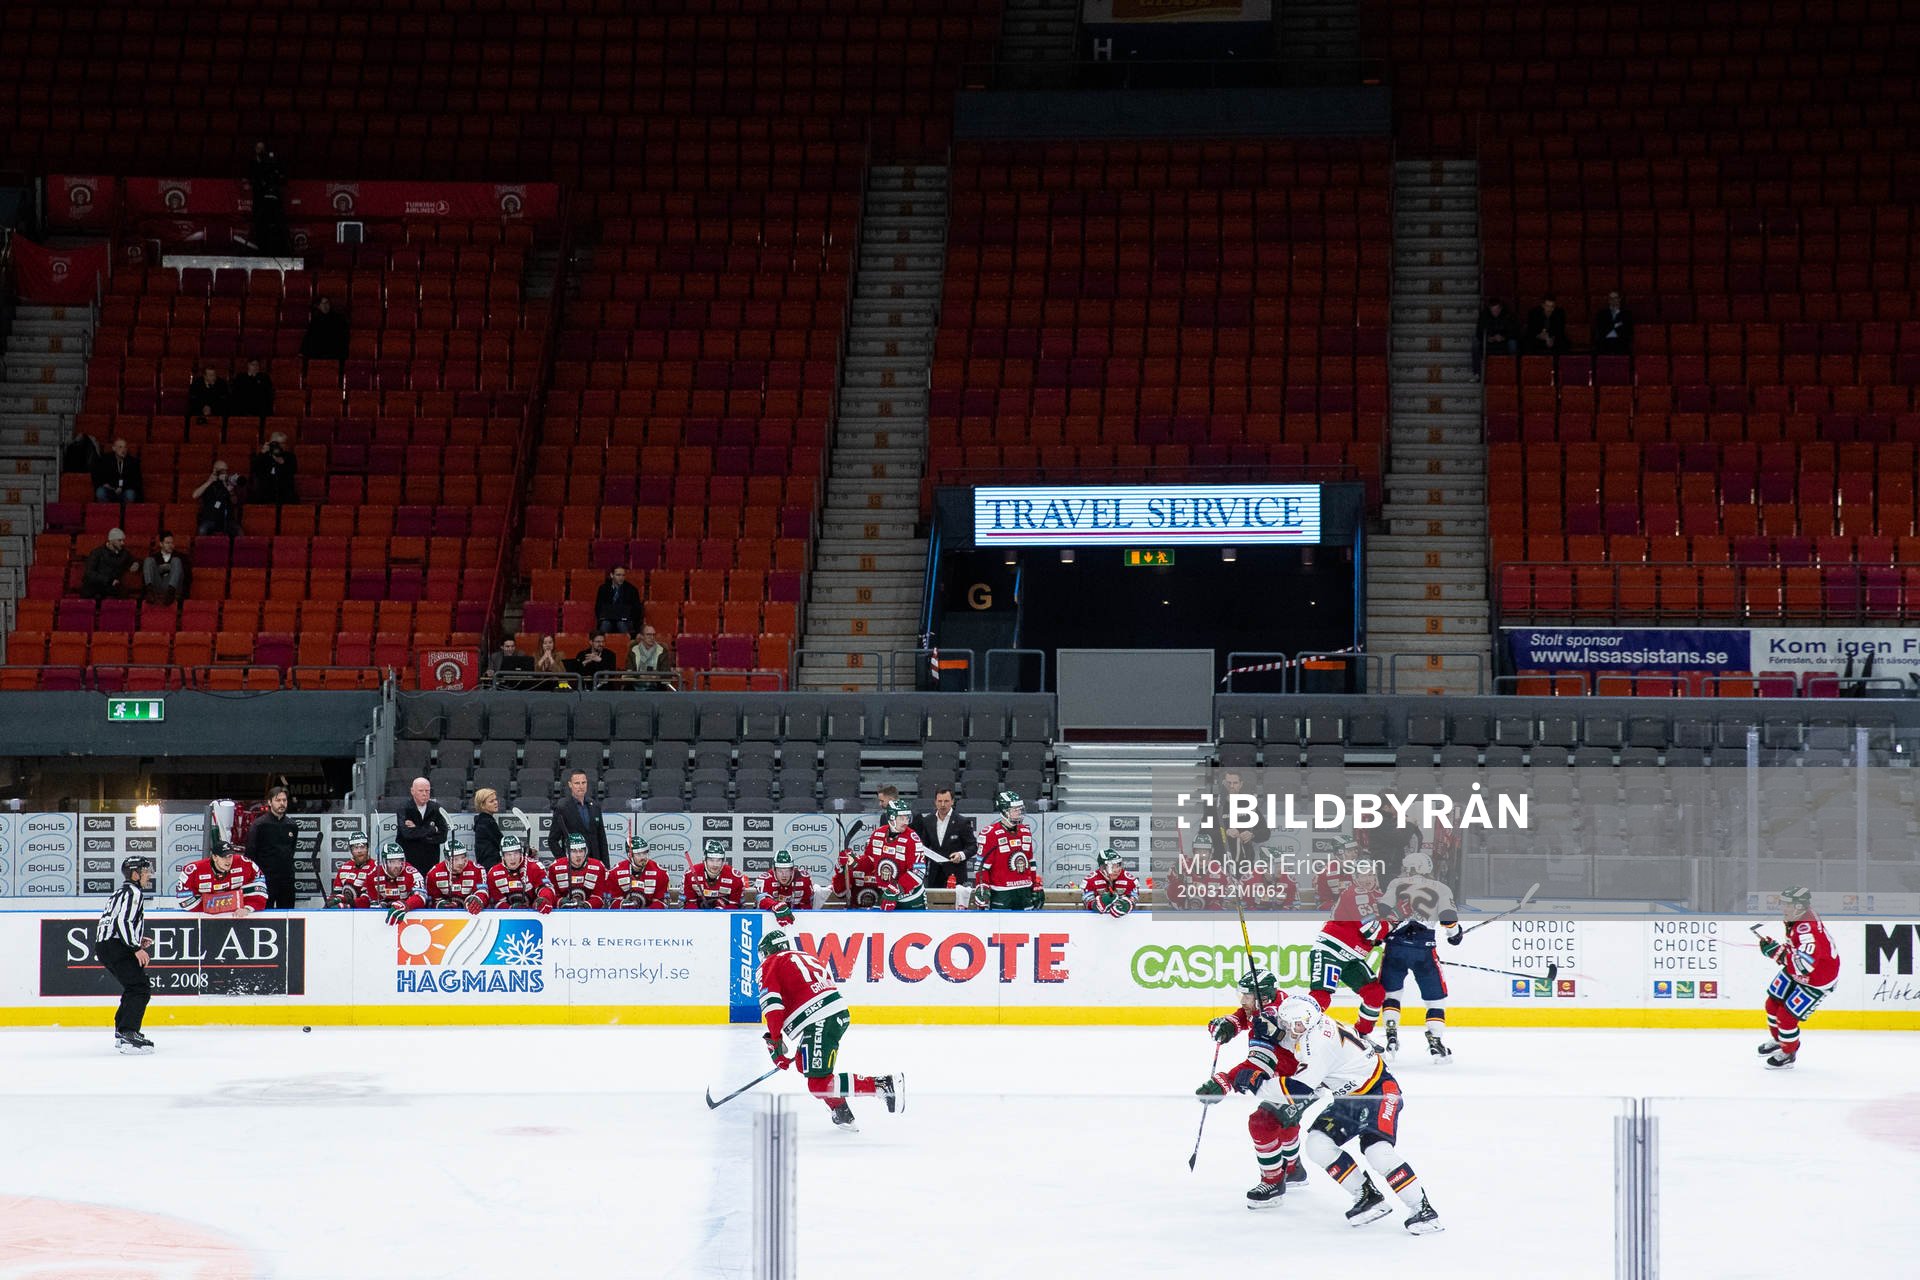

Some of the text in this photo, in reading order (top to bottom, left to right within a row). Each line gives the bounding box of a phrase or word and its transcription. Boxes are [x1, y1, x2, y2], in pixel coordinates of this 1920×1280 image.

[1094, 38, 1112, 60] H
[986, 496, 1303, 530] TRAVEL SERVICE
[865, 526, 877, 536] 12
[861, 557, 872, 568] 11
[1426, 554, 1438, 564] 11
[858, 590, 871, 600] 10
[968, 583, 993, 610] G
[1427, 586, 1440, 596] 10
[855, 621, 864, 632] 9
[1531, 634, 1623, 649] Stolt sponsor
[1769, 638, 1920, 657] Kom igen F
[851, 654, 859, 664] 8
[1531, 648, 1729, 664] www.lssassistans.se
[792, 824, 827, 832] BOHUS
[1056, 843, 1092, 851] BOHUS
[915, 853, 926, 864] 72
[28, 864, 64, 872] BOHUS
[1056, 863, 1092, 871] BOHUS
[1512, 921, 1574, 933] NORDIC
[1654, 921, 1717, 934] NORDIC
[66, 927, 279, 962] SEL AB
[551, 937, 694, 947] KYL & ENERGITEKNIK
[1512, 938, 1574, 951] CHOICE
[1654, 939, 1717, 952] CHOICE
[1865, 924, 1920, 974] M
[795, 932, 1070, 984] WICOTE
[1512, 955, 1574, 969] HOTELS
[1654, 956, 1717, 970] HOTELS
[149, 972, 209, 988] st. 2008
[554, 963, 690, 985] hagmanskyl.se
[397, 970, 544, 993] HAGMANS
[804, 1000, 824, 1017] SKF
[813, 1019, 826, 1067] STENA
